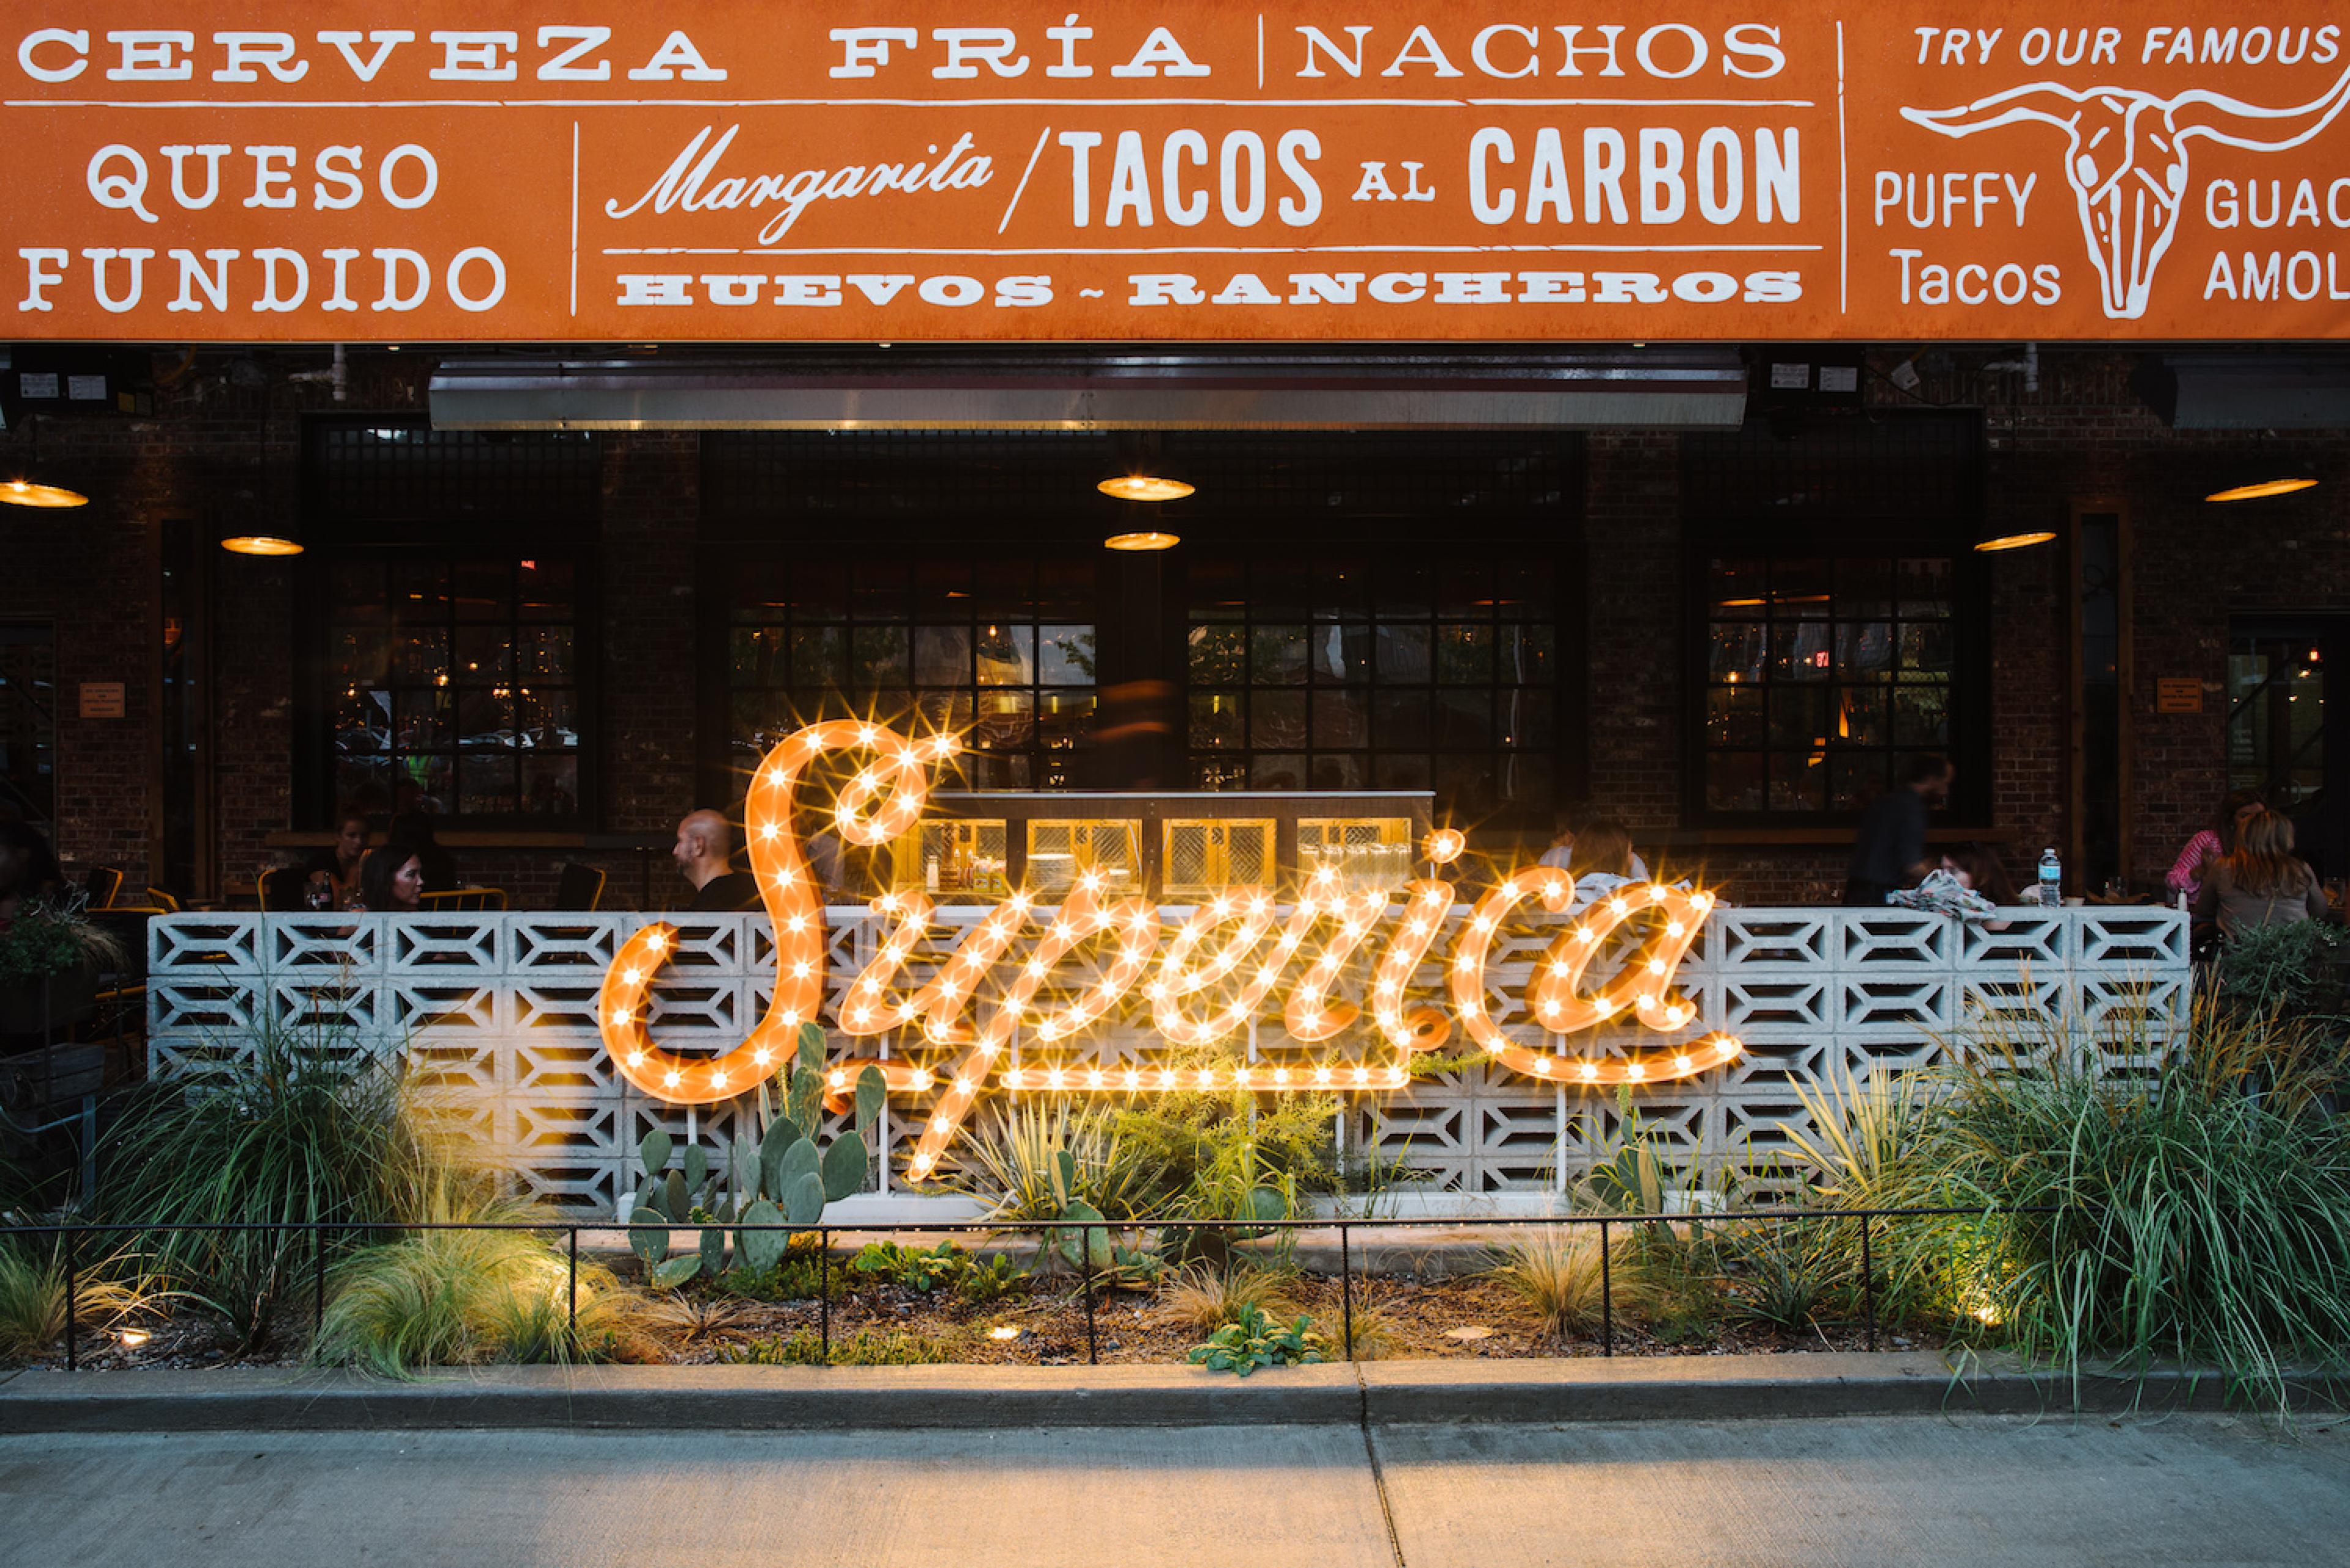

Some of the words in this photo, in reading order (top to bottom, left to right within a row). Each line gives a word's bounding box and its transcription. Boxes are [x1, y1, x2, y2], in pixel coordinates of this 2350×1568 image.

[17, 25, 728, 83] CERVEZA
[829, 13, 1211, 79] FRÍA
[1295, 23, 1786, 79] NACHOS
[1914, 26, 2003, 65] TRY
[2019, 27, 2122, 66] OUR
[2141, 24, 2341, 65] FAMOUS
[87, 143, 438, 223] QUESO
[605, 123, 994, 246] Margarita
[1058, 129, 1322, 228] TACOS
[1351, 161, 1436, 201] AL
[1469, 126, 1800, 225] CARBON
[1874, 170, 2037, 228] PUFFY
[18, 247, 506, 313] FUNDIDO
[616, 274, 1053, 307] HUEVOS
[1128, 271, 1802, 306] RANCHEROS
[1889, 248, 2061, 306] Tacos
[599, 719, 1744, 1182] Superica
